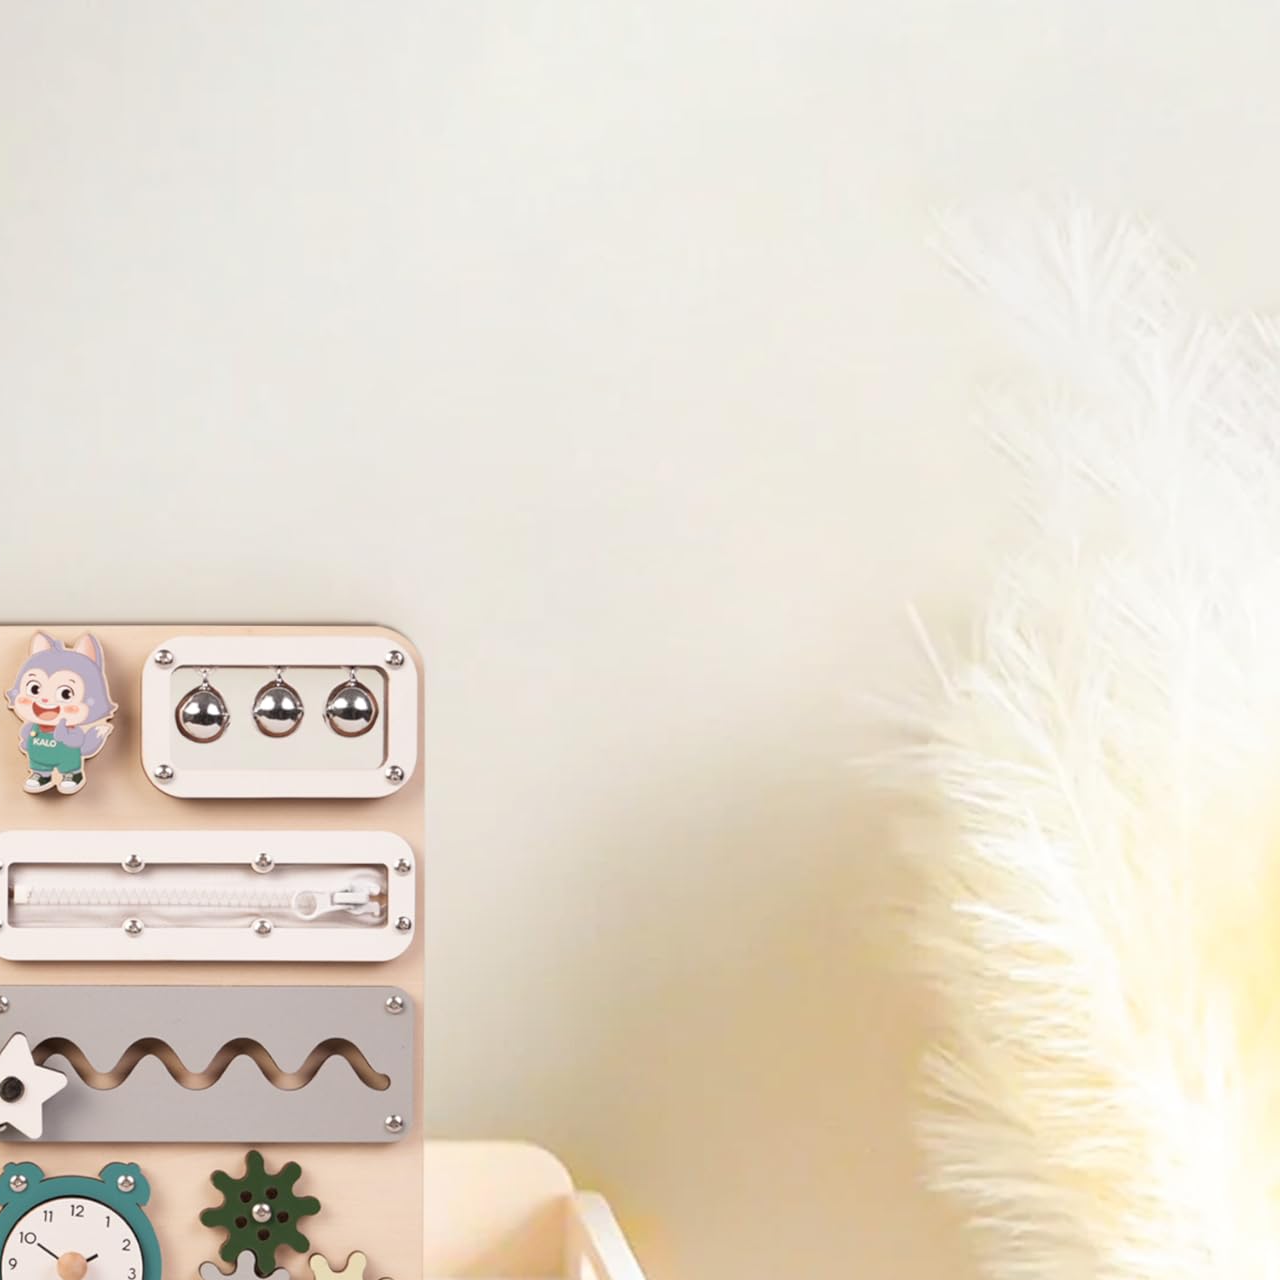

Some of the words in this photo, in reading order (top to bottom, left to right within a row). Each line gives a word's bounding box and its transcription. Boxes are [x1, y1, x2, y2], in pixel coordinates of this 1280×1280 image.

[32, 737, 57, 748] KALO
[43, 1210, 53, 1223] 11
[70, 1204, 85, 1217] 12
[105, 1215, 111, 1228] 1
[19, 1231, 37, 1245] 10
[121, 1238, 131, 1251] 2
[8, 1257, 18, 1270] 9
[127, 1267, 137, 1280] 3
